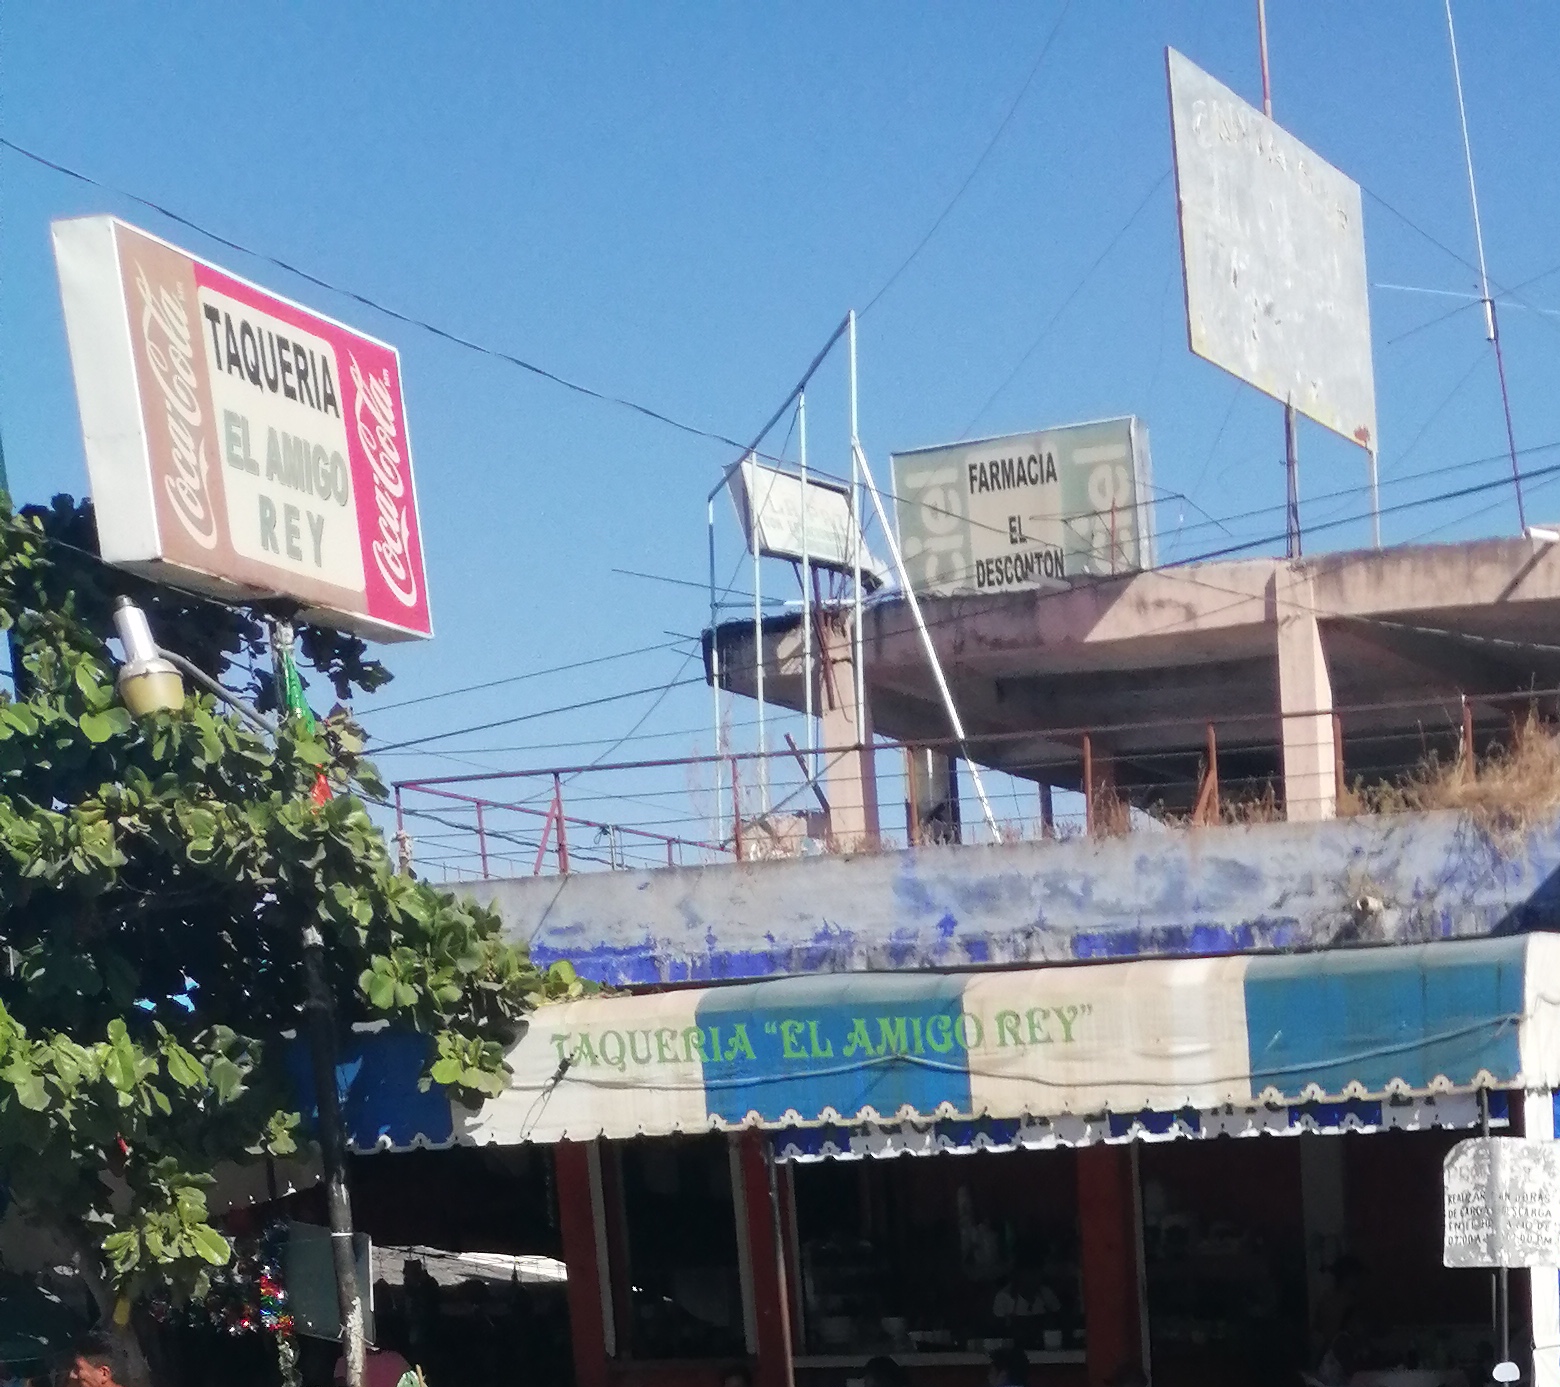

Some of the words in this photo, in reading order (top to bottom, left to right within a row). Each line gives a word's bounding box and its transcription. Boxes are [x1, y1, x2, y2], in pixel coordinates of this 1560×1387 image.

[203, 303, 341, 418] TAQUERIA
[135, 259, 218, 549] Coca-Cola
[223, 409, 260, 476] EL
[265, 426, 349, 507] AMIGO
[348, 350, 417, 607] Coca-Cola
[967, 452, 1058, 495] FARMACIA
[258, 494, 326, 567] REY
[1008, 515, 1027, 545] EL
[975, 549, 1065, 588] DESCONTON
[550, 1023, 757, 1072] TAQUERIA
[843, 1012, 984, 1057] AMIGO
